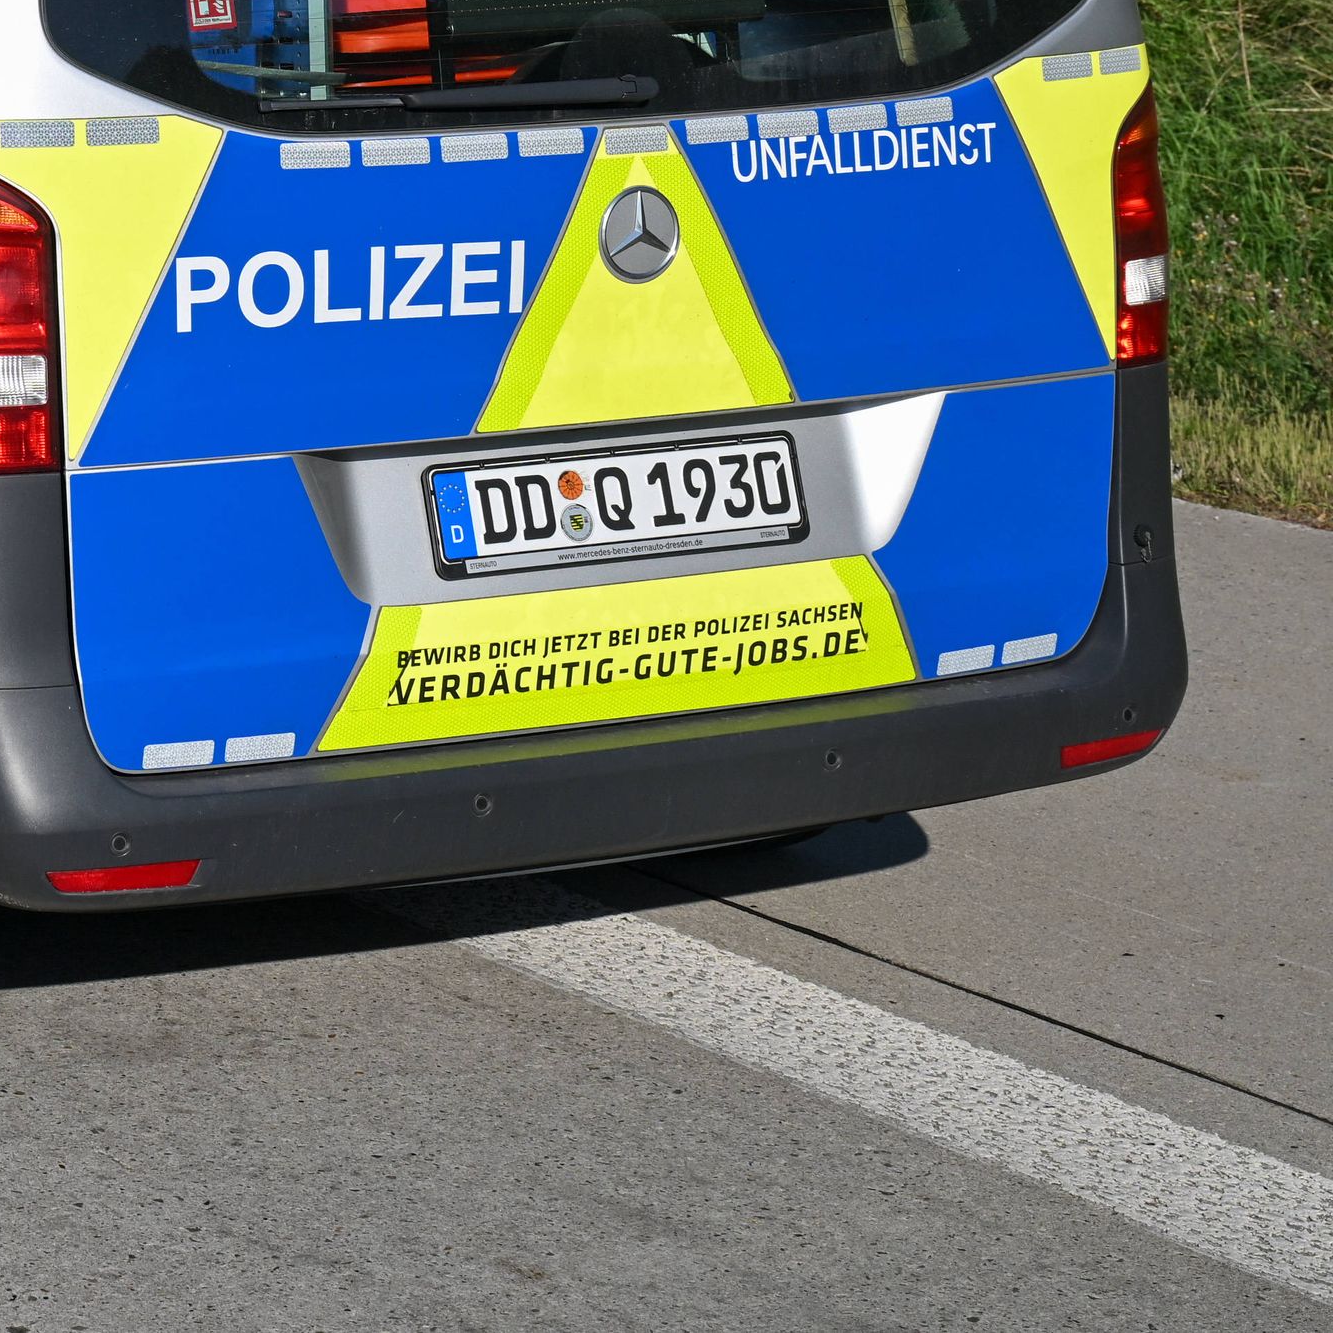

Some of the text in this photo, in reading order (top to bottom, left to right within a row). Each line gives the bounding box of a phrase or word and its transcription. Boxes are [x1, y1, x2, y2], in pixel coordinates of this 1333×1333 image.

[731, 122, 997, 183] UNFALLDIENST
[175, 240, 526, 334] POLIZEI
[474, 451, 793, 545] DD Q 1930
[450, 525, 464, 543] D
[557, 538, 704, 561] www.mercedes-benz-sternauto-dresden.de
[395, 629, 861, 705] VERDÄCHTIG-GUTE-JOBS.DE
[397, 602, 863, 668] BEWIRB DICH JETZT BEI DER POLIZEI SACHSEN
